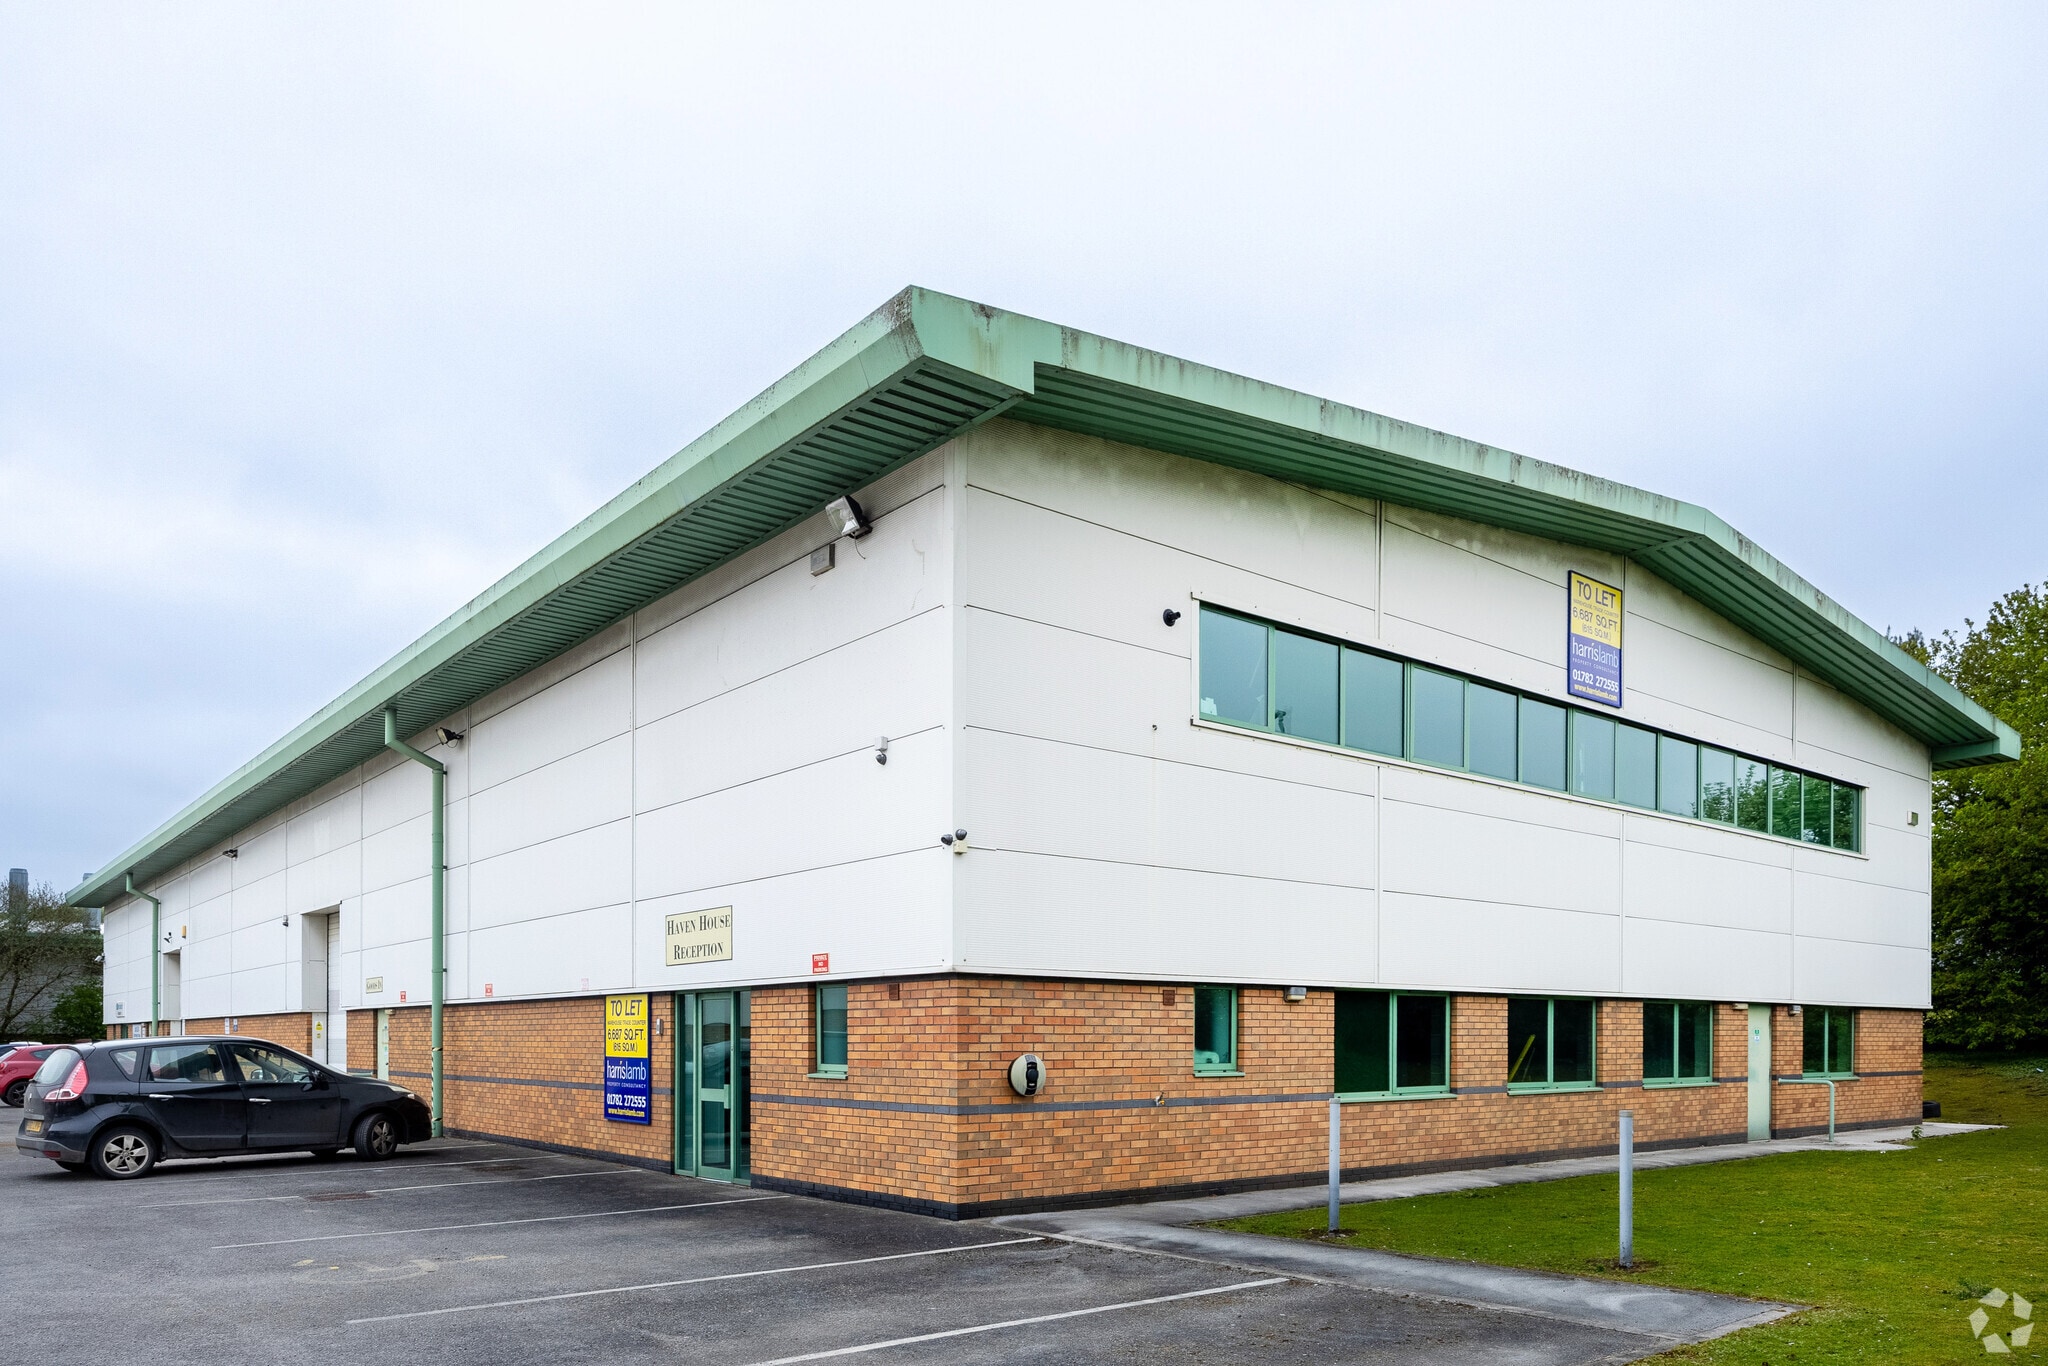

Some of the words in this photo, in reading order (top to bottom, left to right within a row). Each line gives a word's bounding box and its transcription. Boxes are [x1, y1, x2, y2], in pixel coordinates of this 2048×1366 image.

[1577, 580, 1592, 600] TO
[1595, 588, 1616, 609] LET
[1573, 606, 1593, 622] 6,687
[1572, 669, 1594, 685] 01782
[1595, 676, 1619, 692] 272555
[667, 919, 697, 936] HAVEN
[699, 914, 731, 932] HOUSE
[673, 941, 724, 960] RECEPTION
[610, 1000, 622, 1016] TO
[625, 999, 642, 1016] LET
[608, 1028, 622, 1041] 6,687
[606, 1093, 623, 1105] 01782
[624, 1094, 647, 1108] 272555
